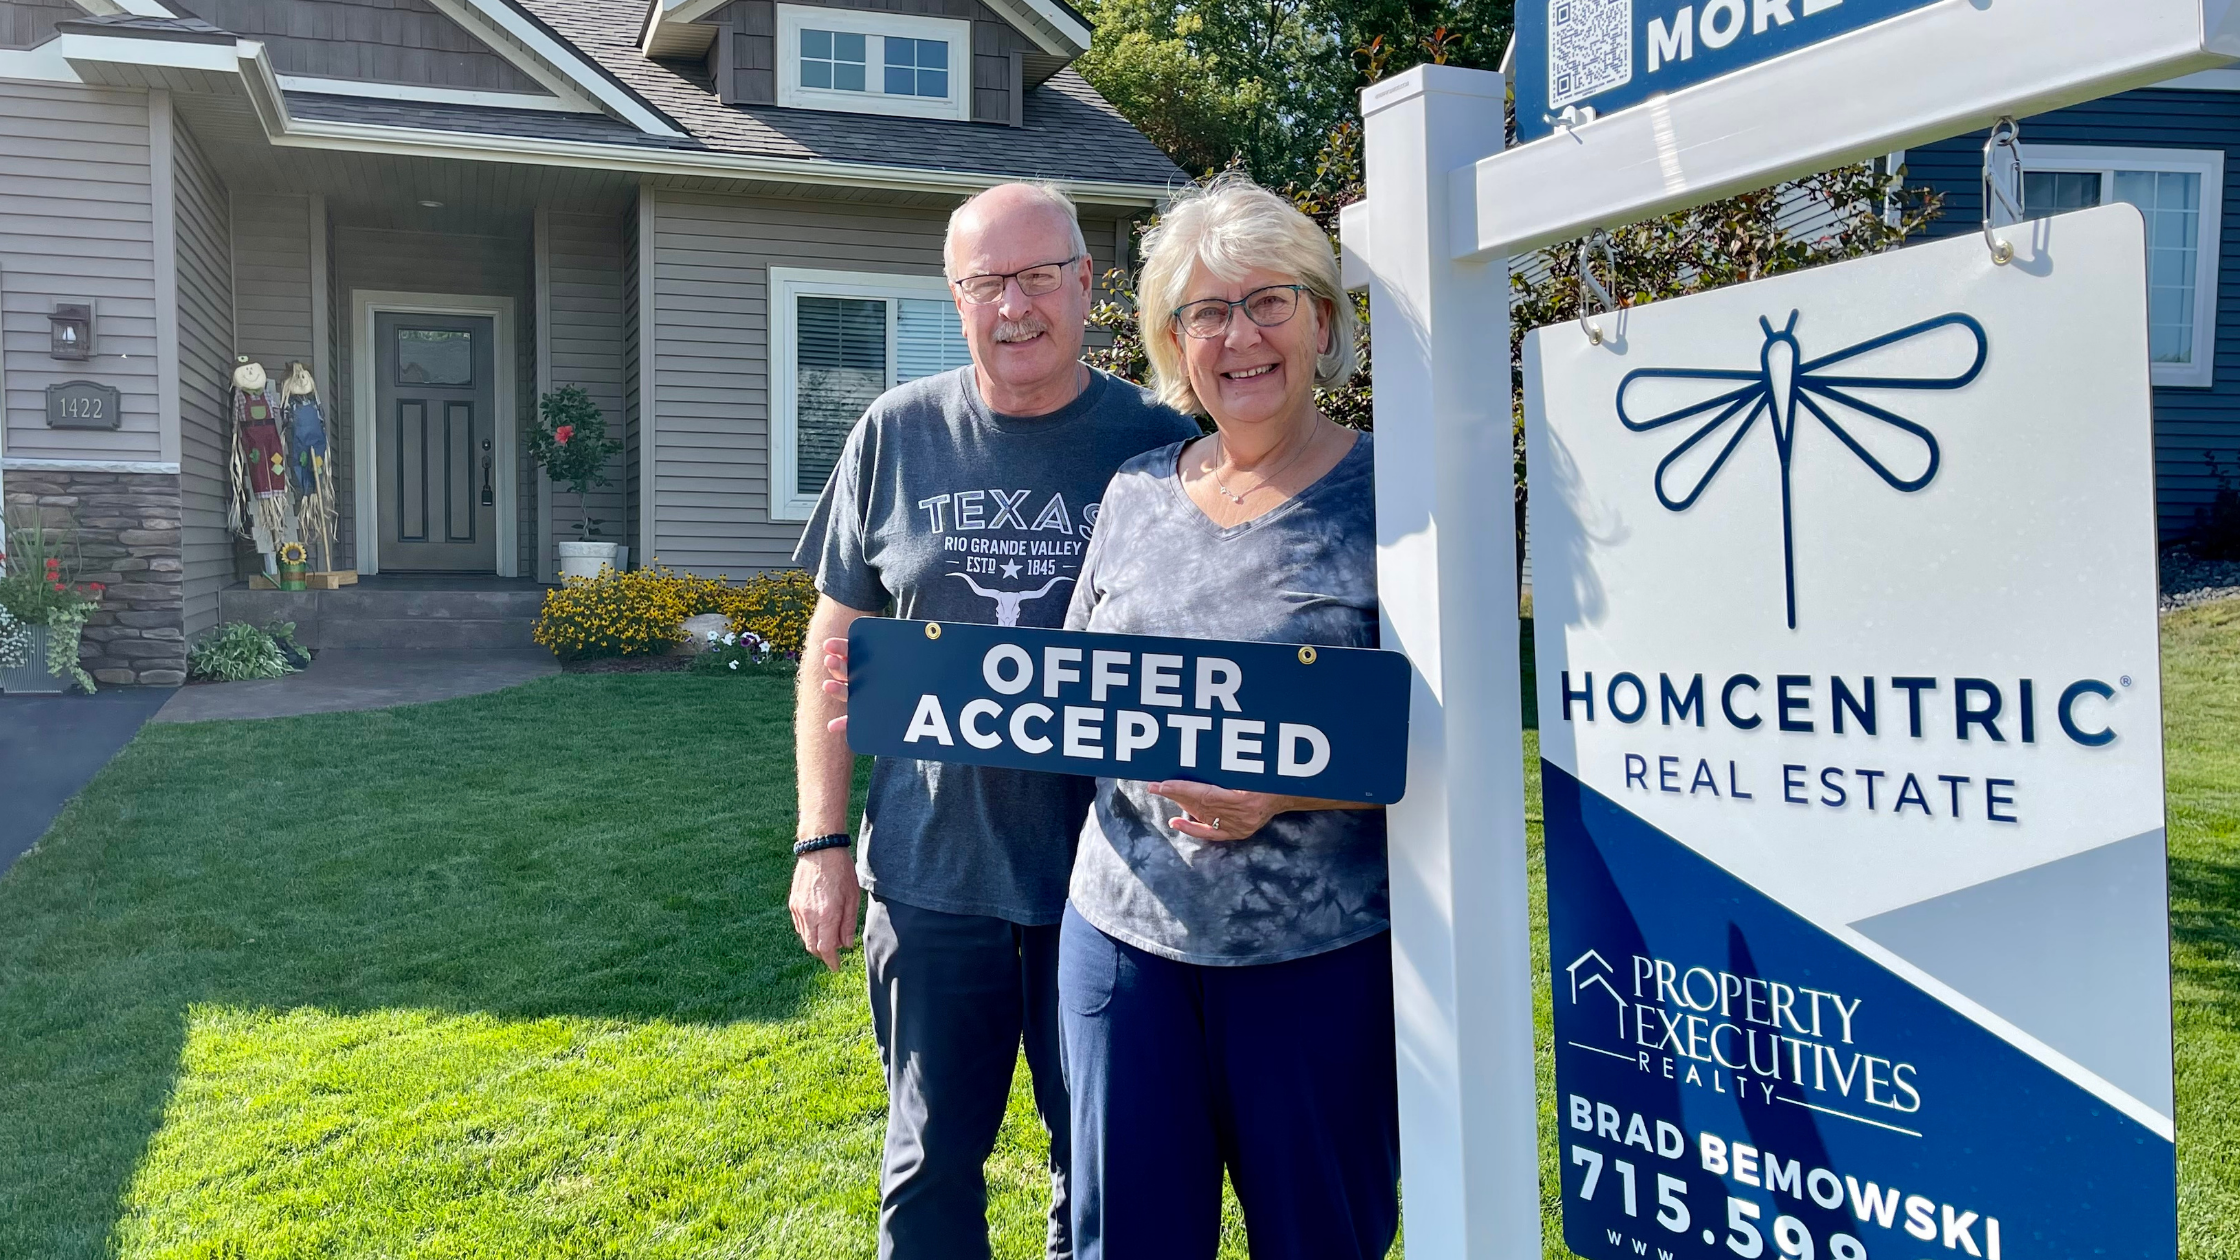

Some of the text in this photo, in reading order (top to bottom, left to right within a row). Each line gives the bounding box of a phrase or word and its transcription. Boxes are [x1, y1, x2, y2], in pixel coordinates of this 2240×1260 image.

[60, 398, 103, 419] 1422
[918, 489, 1101, 541] TEXAS
[944, 537, 1082, 556] RIO GRANDE VALLEY
[966, 556, 1056, 576] ESTD 1845
[982, 643, 1243, 712] OFFER
[903, 694, 1331, 778] ACCEPTED
[1625, 753, 2018, 823] REAL ESTATE
[1632, 955, 1862, 1044] PROPERTY
[1634, 1003, 1921, 1113] EXECUTIVES
[1638, 1051, 1775, 1106] REALTY
[1569, 1093, 2001, 1260] BRAD BEMOWSKI
